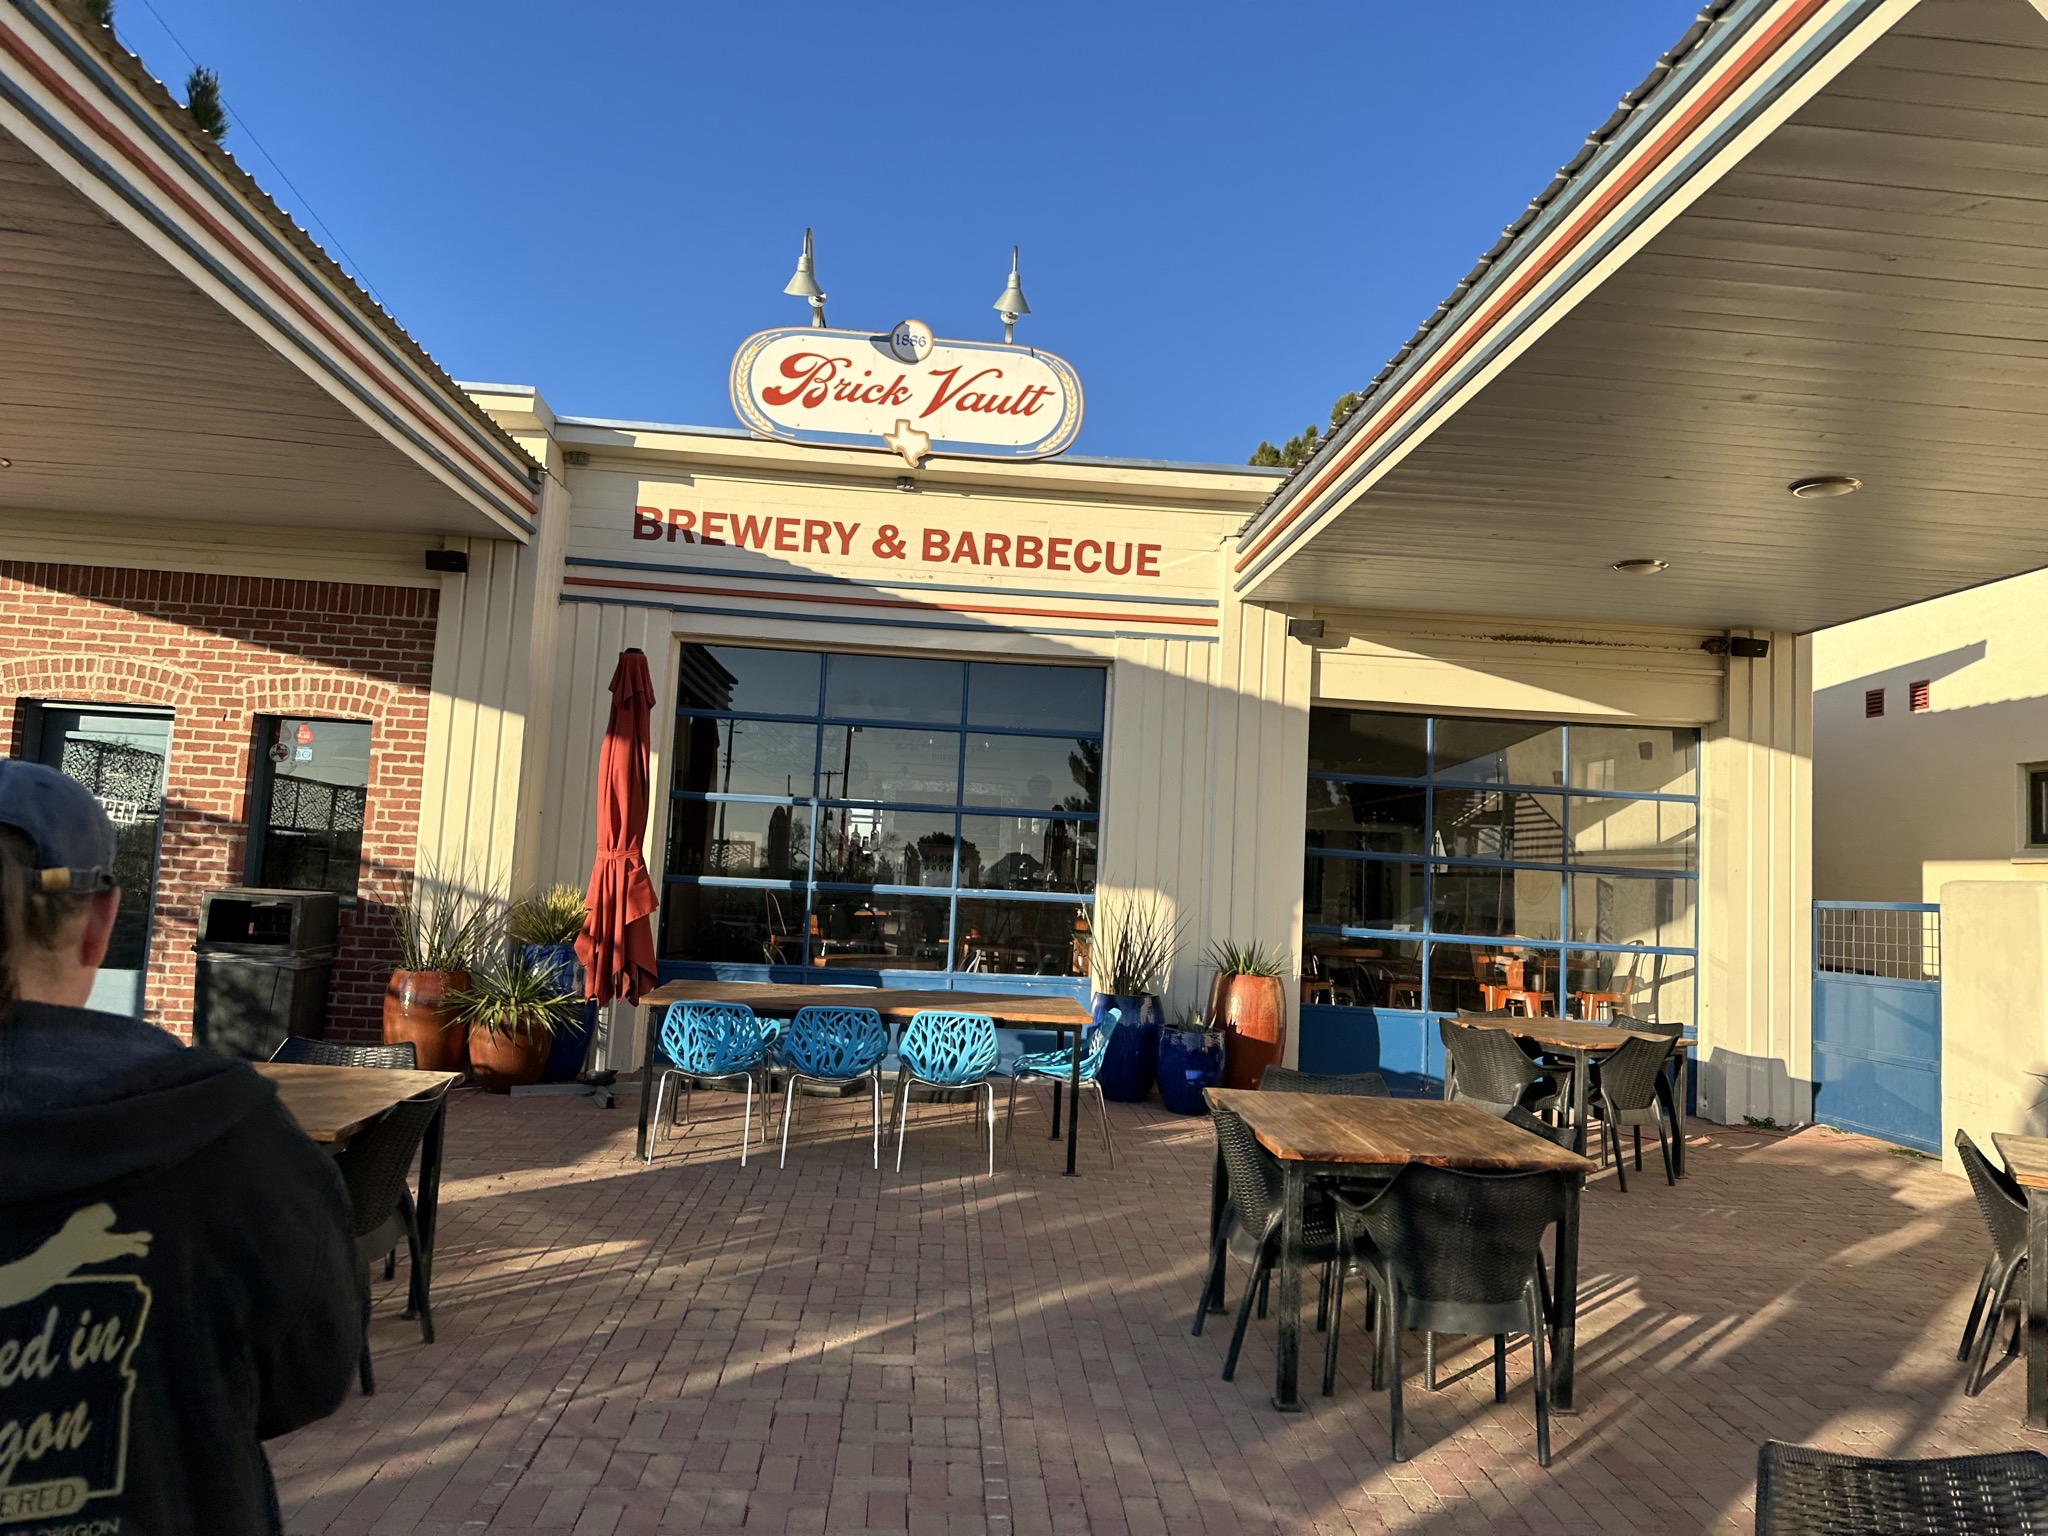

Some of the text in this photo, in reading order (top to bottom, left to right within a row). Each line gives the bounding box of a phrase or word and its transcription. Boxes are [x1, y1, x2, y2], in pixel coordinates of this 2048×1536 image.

[896, 333, 927, 348] 1886
[762, 352, 1056, 419] Brick Vault
[633, 506, 1161, 577] BREWERY & BARBECUE
[105, 800, 136, 822] PEN
[0, 1305, 125, 1388] ed in
[0, 1400, 93, 1488] gon
